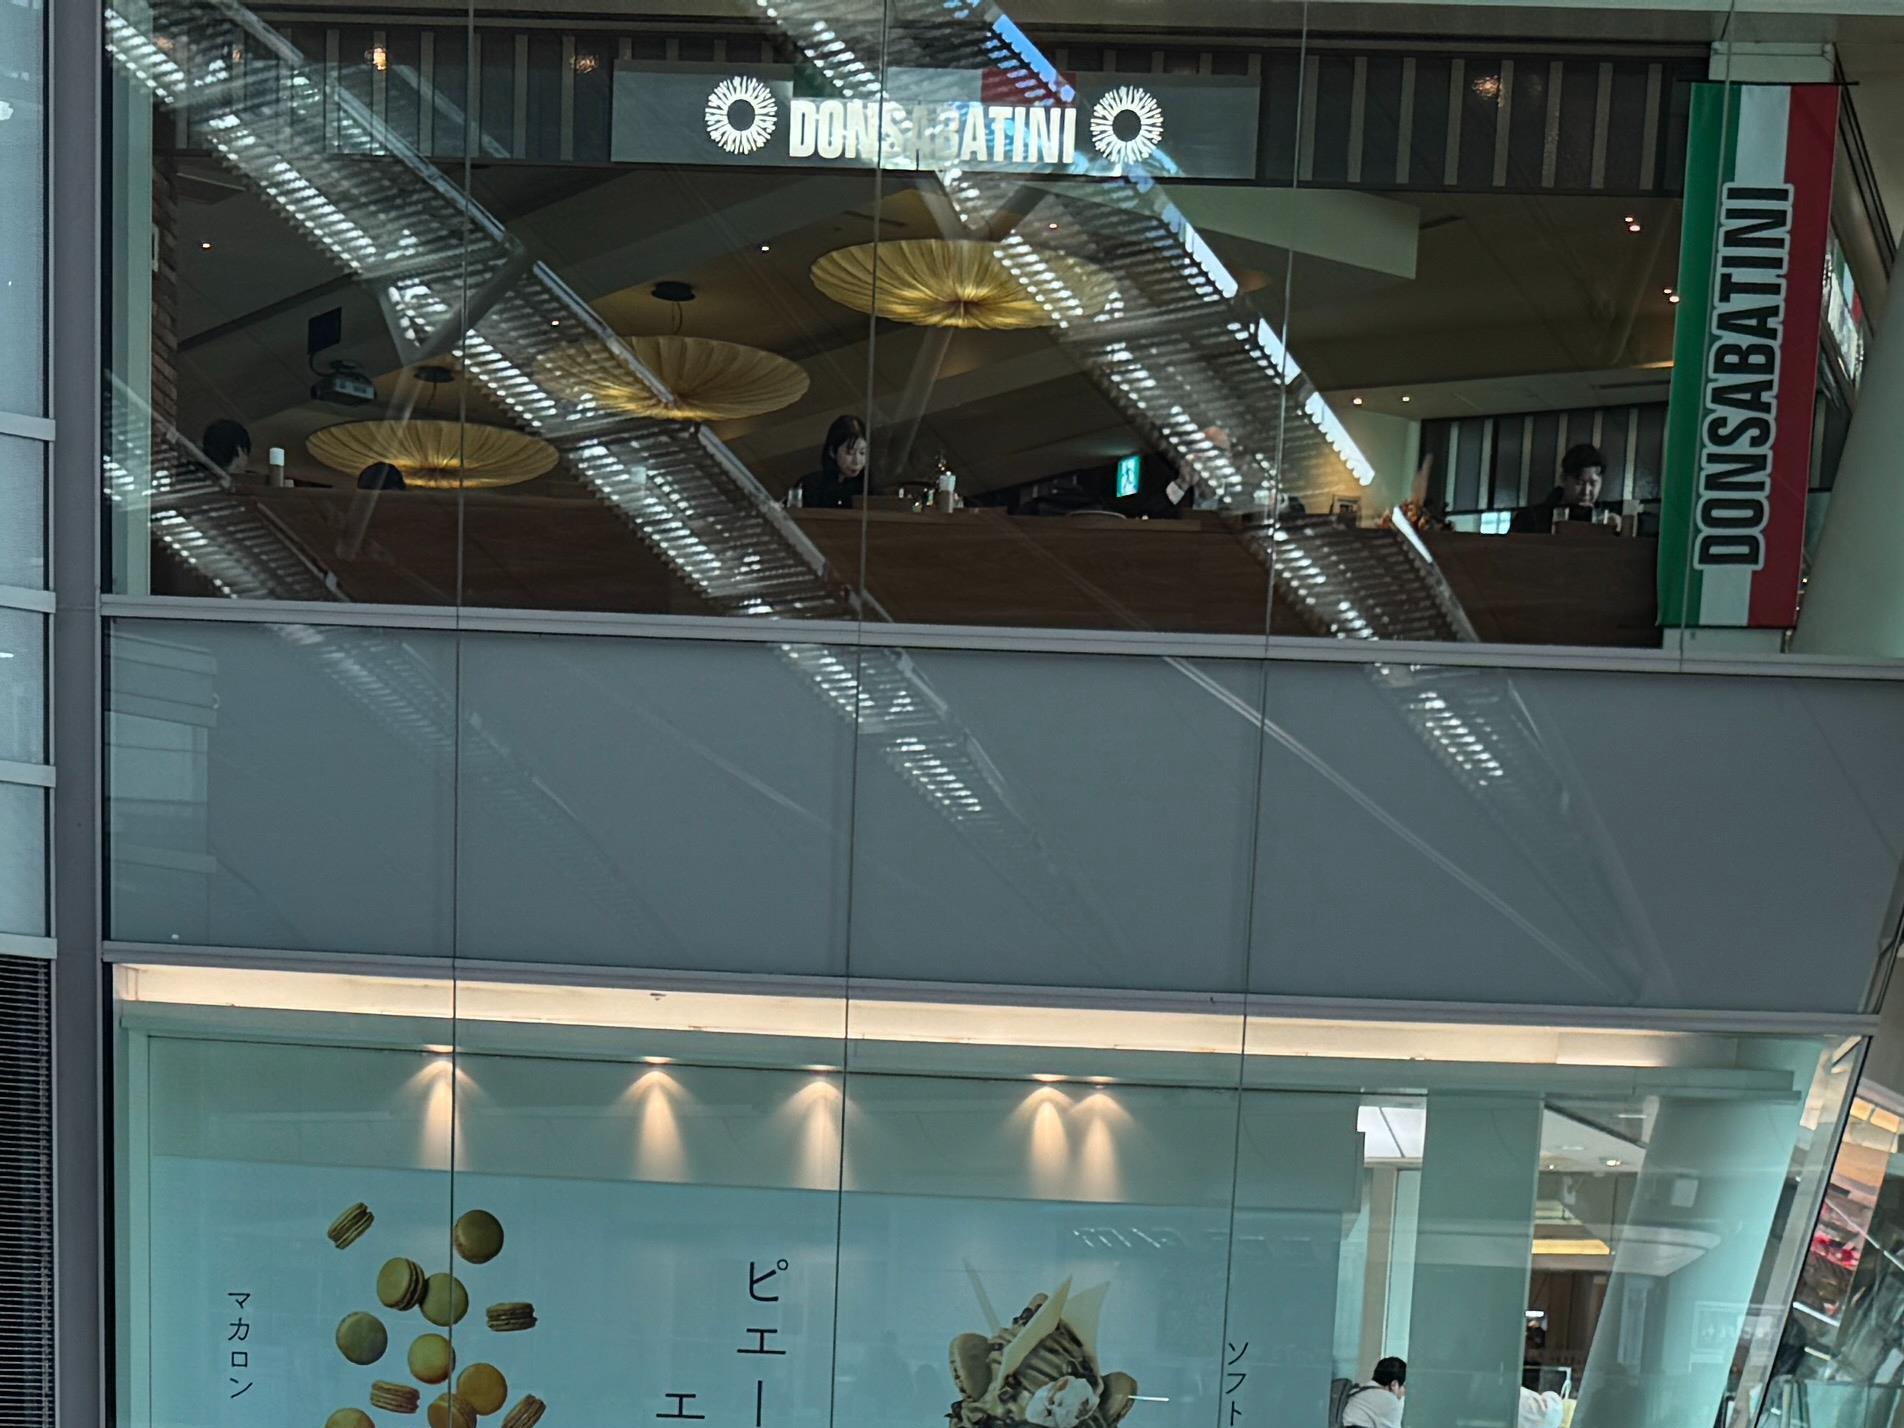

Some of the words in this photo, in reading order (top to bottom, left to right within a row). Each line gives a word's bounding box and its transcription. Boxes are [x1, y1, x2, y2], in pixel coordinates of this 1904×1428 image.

[1693, 183, 1795, 570] DONSABATINI
[227, 1290, 254, 1401] マカロン
